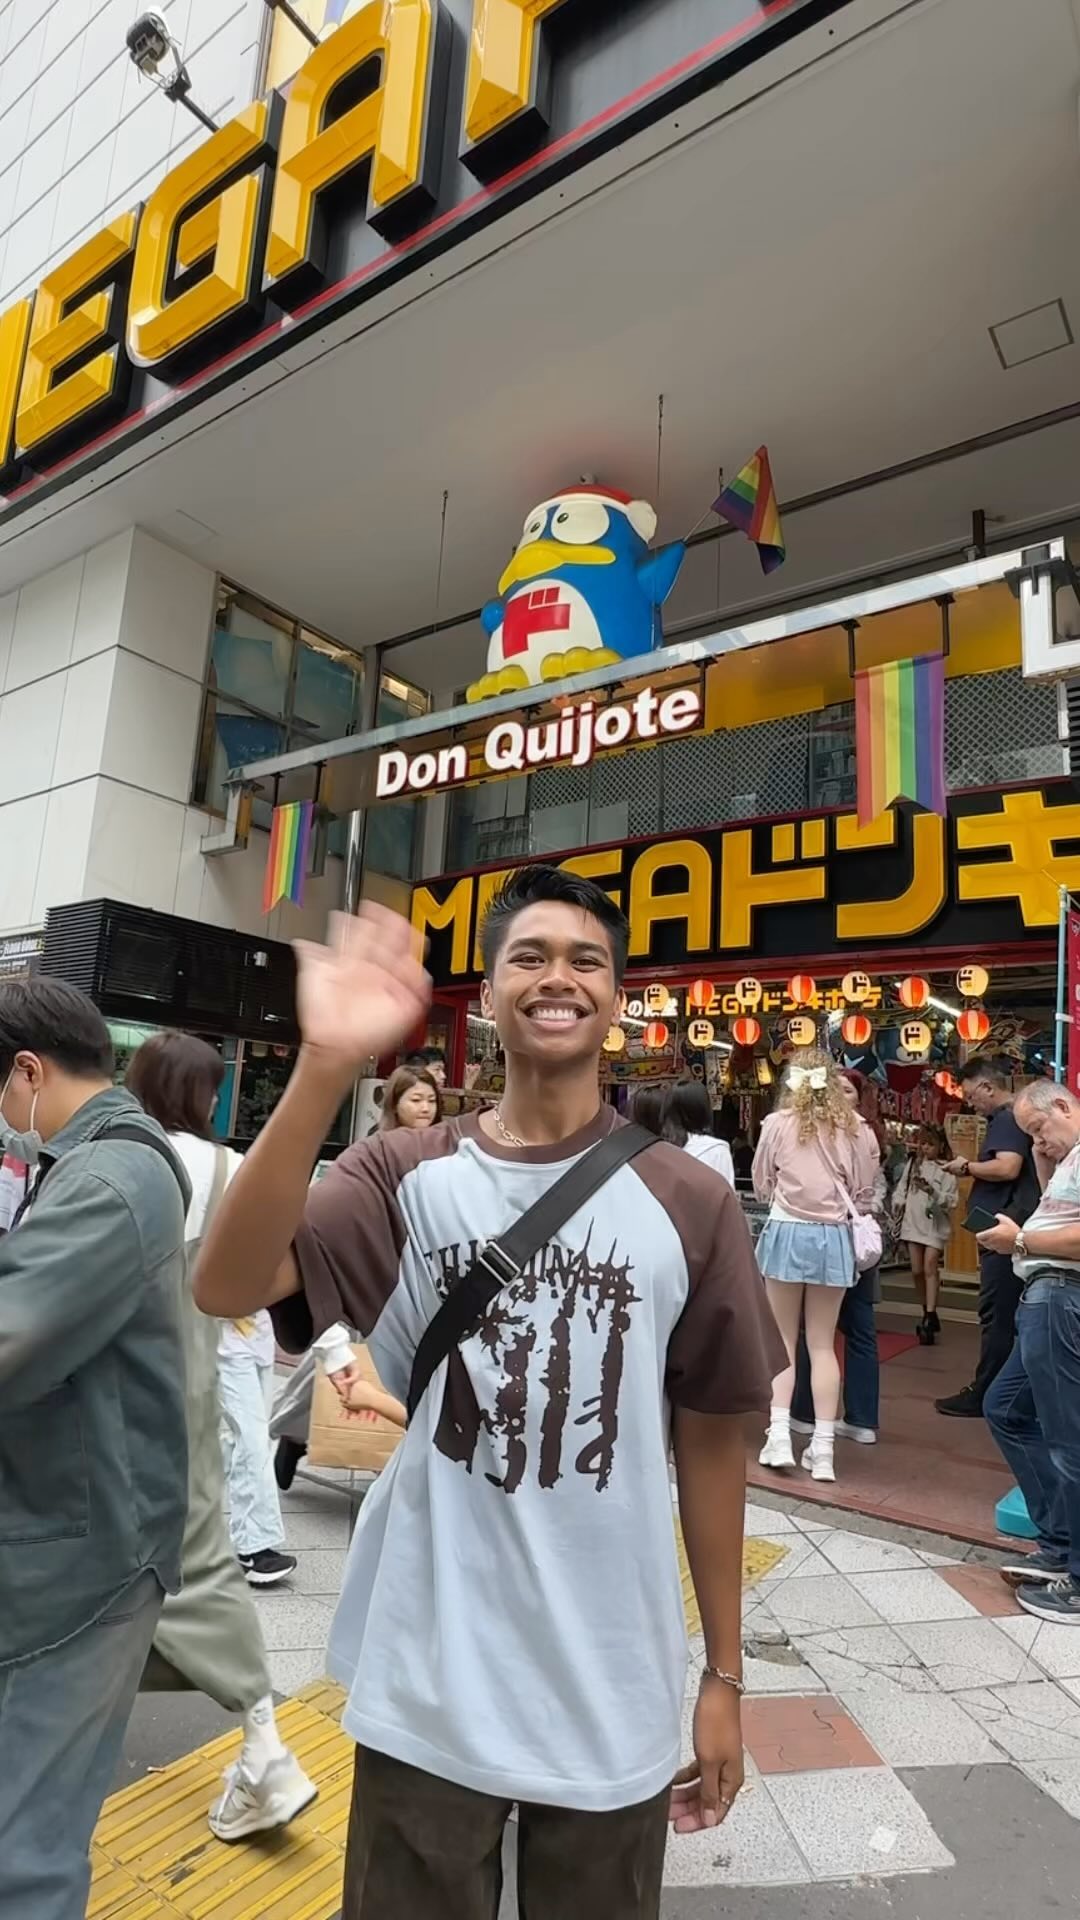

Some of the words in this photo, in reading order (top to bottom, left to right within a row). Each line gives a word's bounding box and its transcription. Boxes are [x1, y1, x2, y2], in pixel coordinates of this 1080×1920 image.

[502, 586, 571, 660] ド
[376, 744, 468, 798] Don
[485, 686, 702, 766] Quijote
